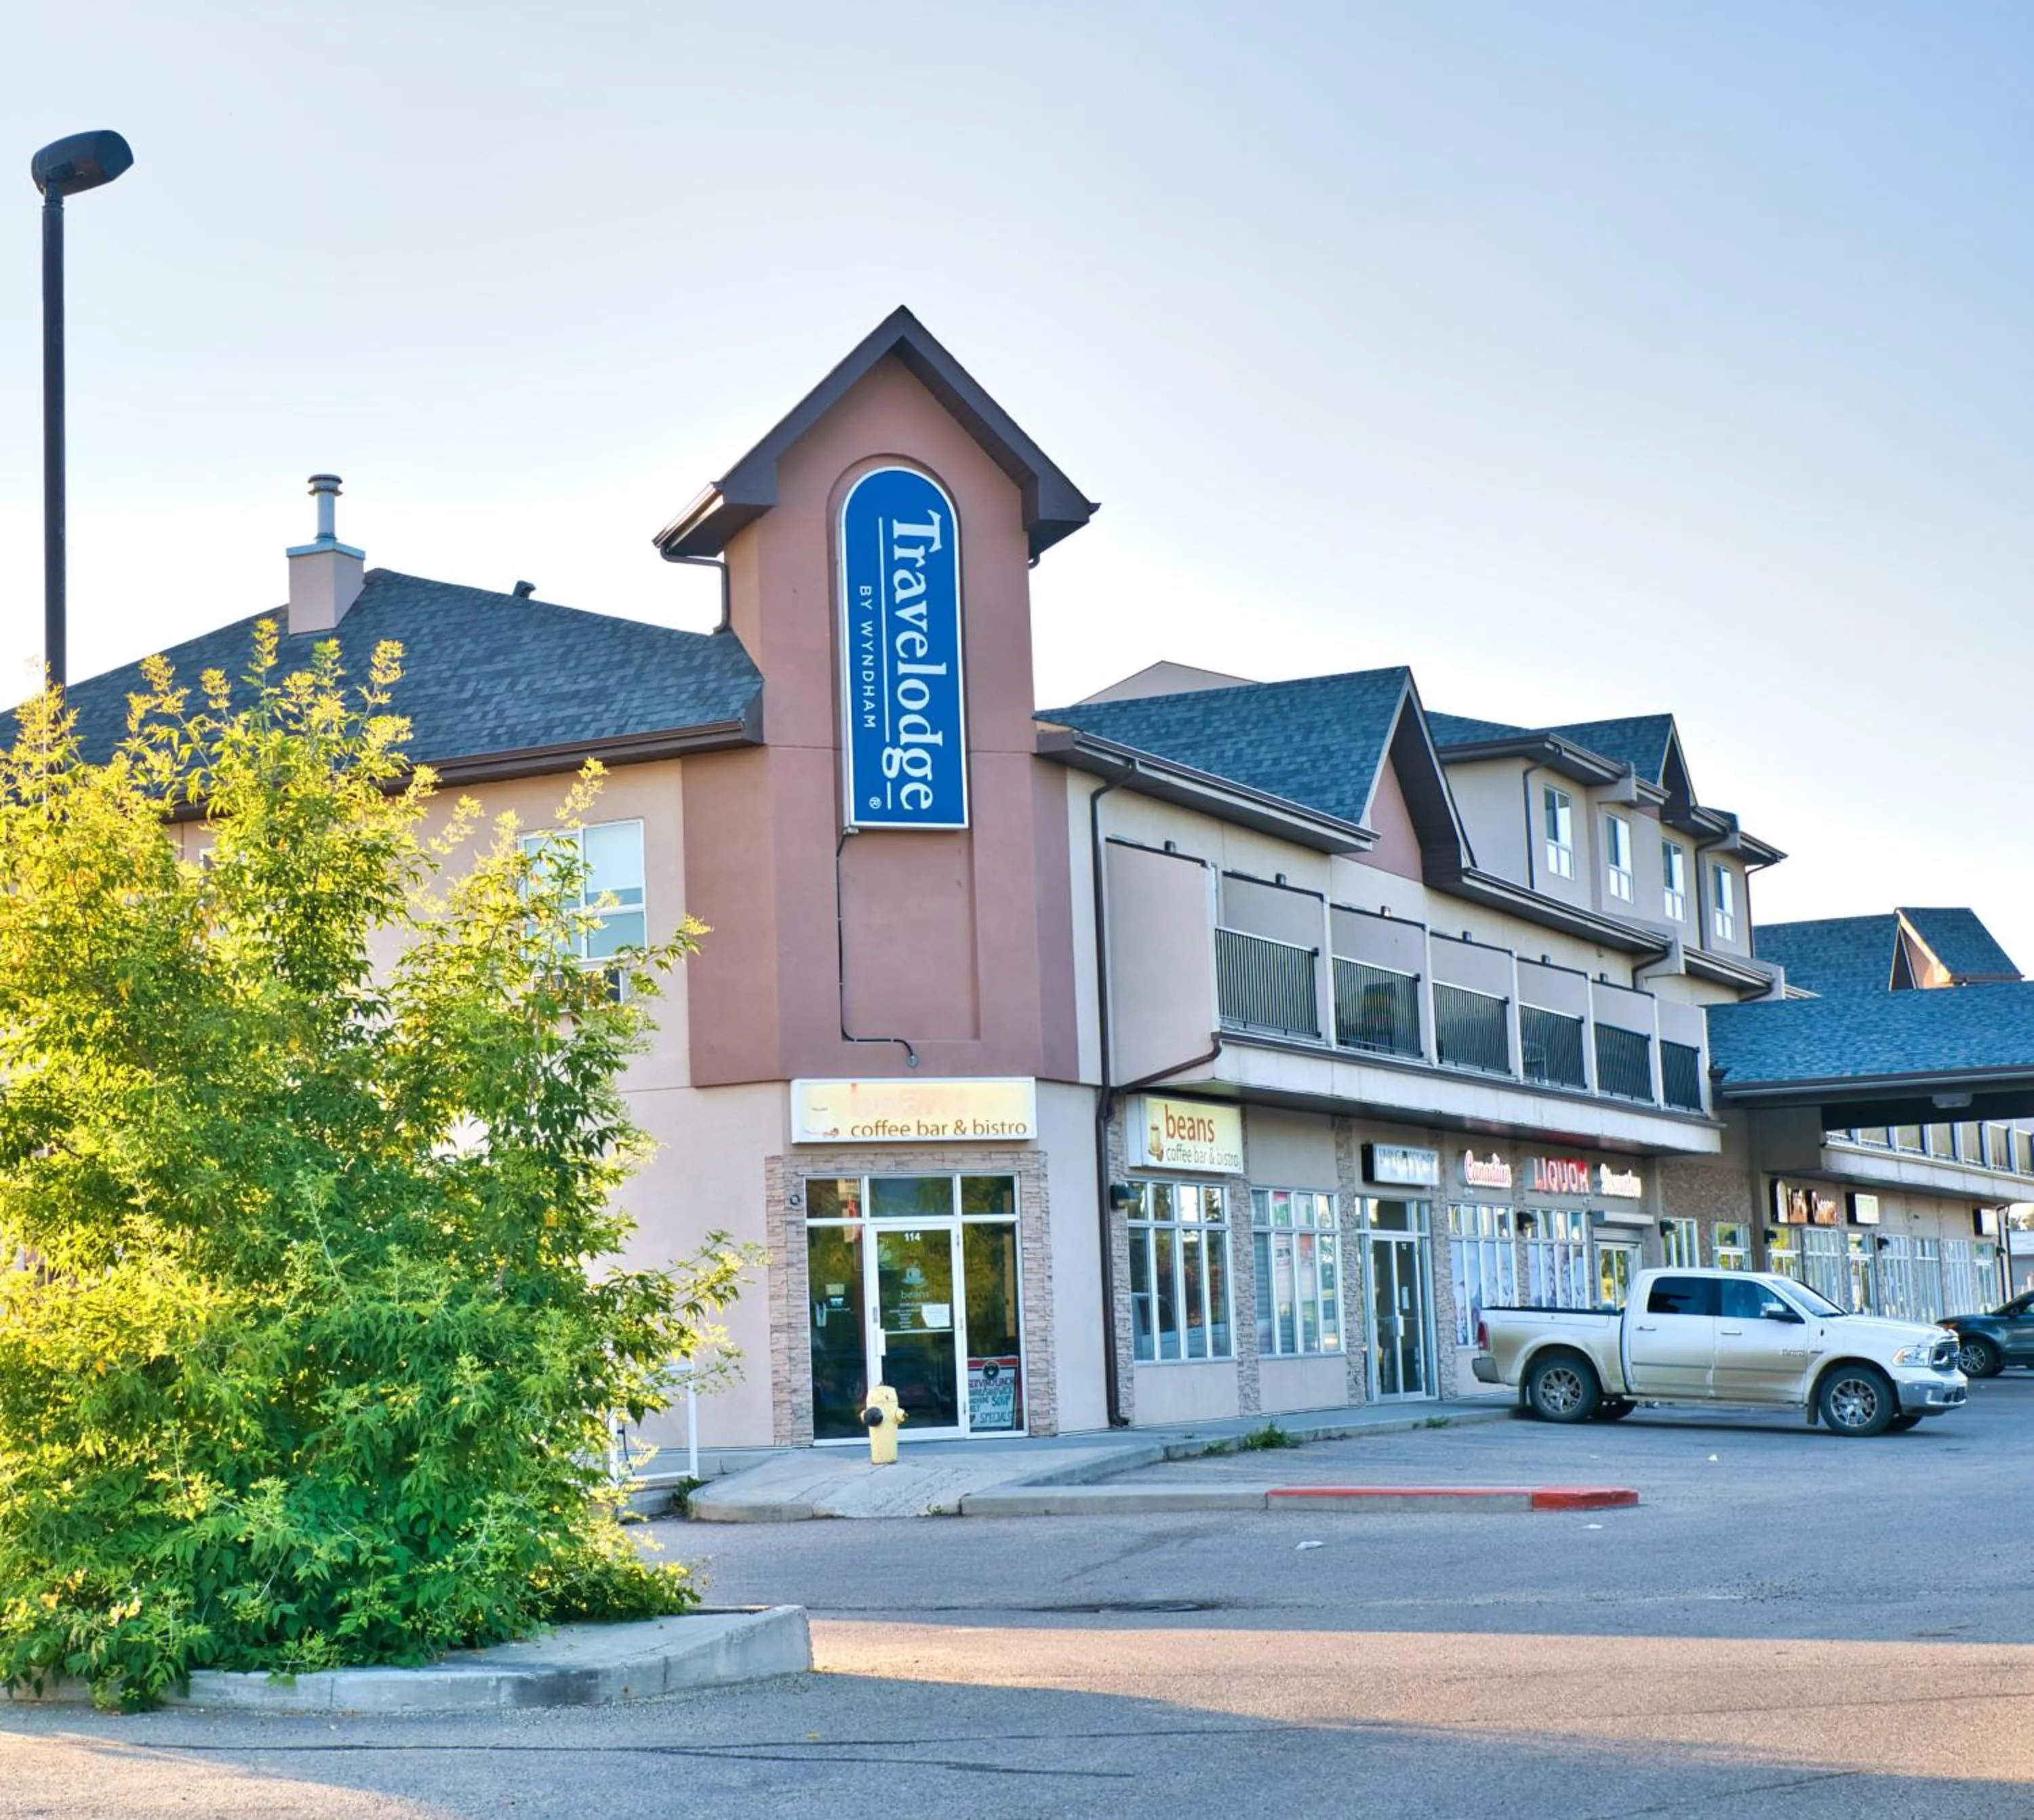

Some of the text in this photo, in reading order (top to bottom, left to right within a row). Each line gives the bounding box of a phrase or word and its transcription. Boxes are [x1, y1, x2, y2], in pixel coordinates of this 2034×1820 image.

[859, 585, 878, 729] BY WYNDHAM
[881, 509, 947, 810] Travelodge
[850, 1118, 1027, 1138] coffee bar & bistro
[1164, 1103, 1215, 1143] beans
[1166, 1144, 1239, 1167] coffee bar & bistro
[1533, 1156, 1590, 1193] LIQUOR
[904, 1232, 921, 1242] 114
